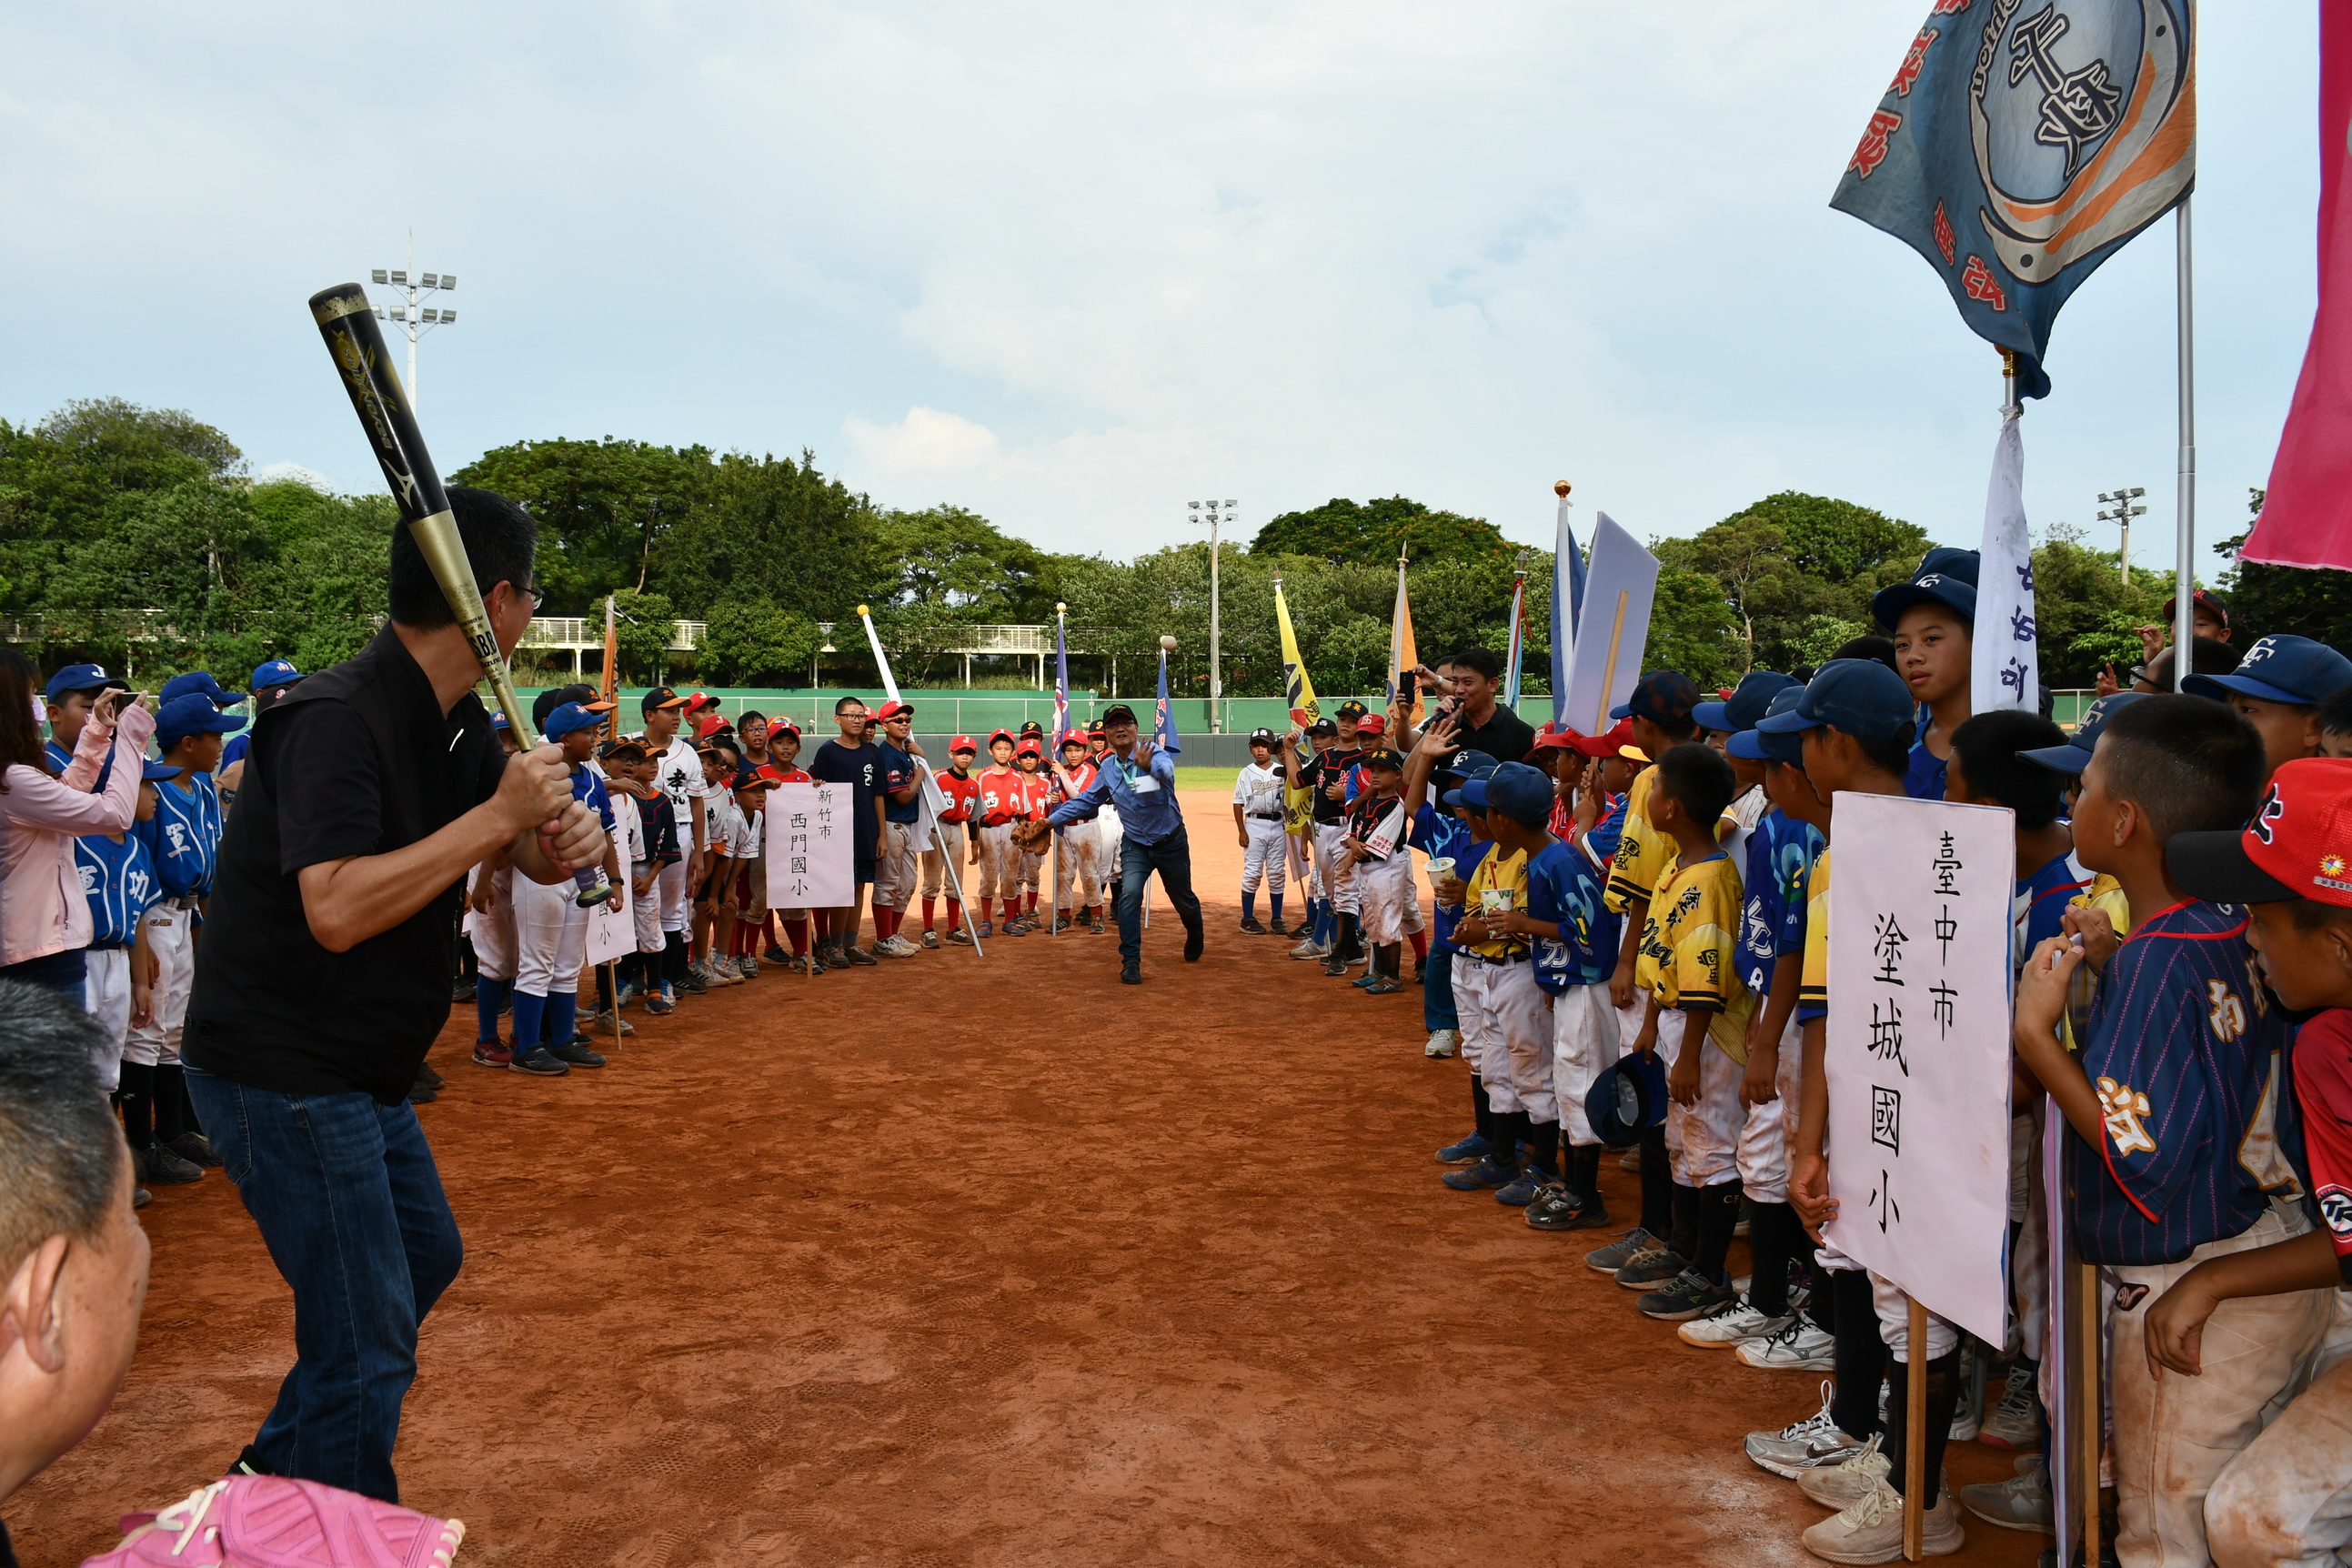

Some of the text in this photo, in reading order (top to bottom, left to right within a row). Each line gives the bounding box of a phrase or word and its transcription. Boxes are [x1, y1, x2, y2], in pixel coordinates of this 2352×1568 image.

[789, 811, 808, 897] 西門國小
[818, 789, 833, 839] 新竹市
[1928, 830, 1963, 1041] 臺中市
[1552, 972, 1568, 986] 7
[1867, 912, 1909, 1235] 塗城國小
